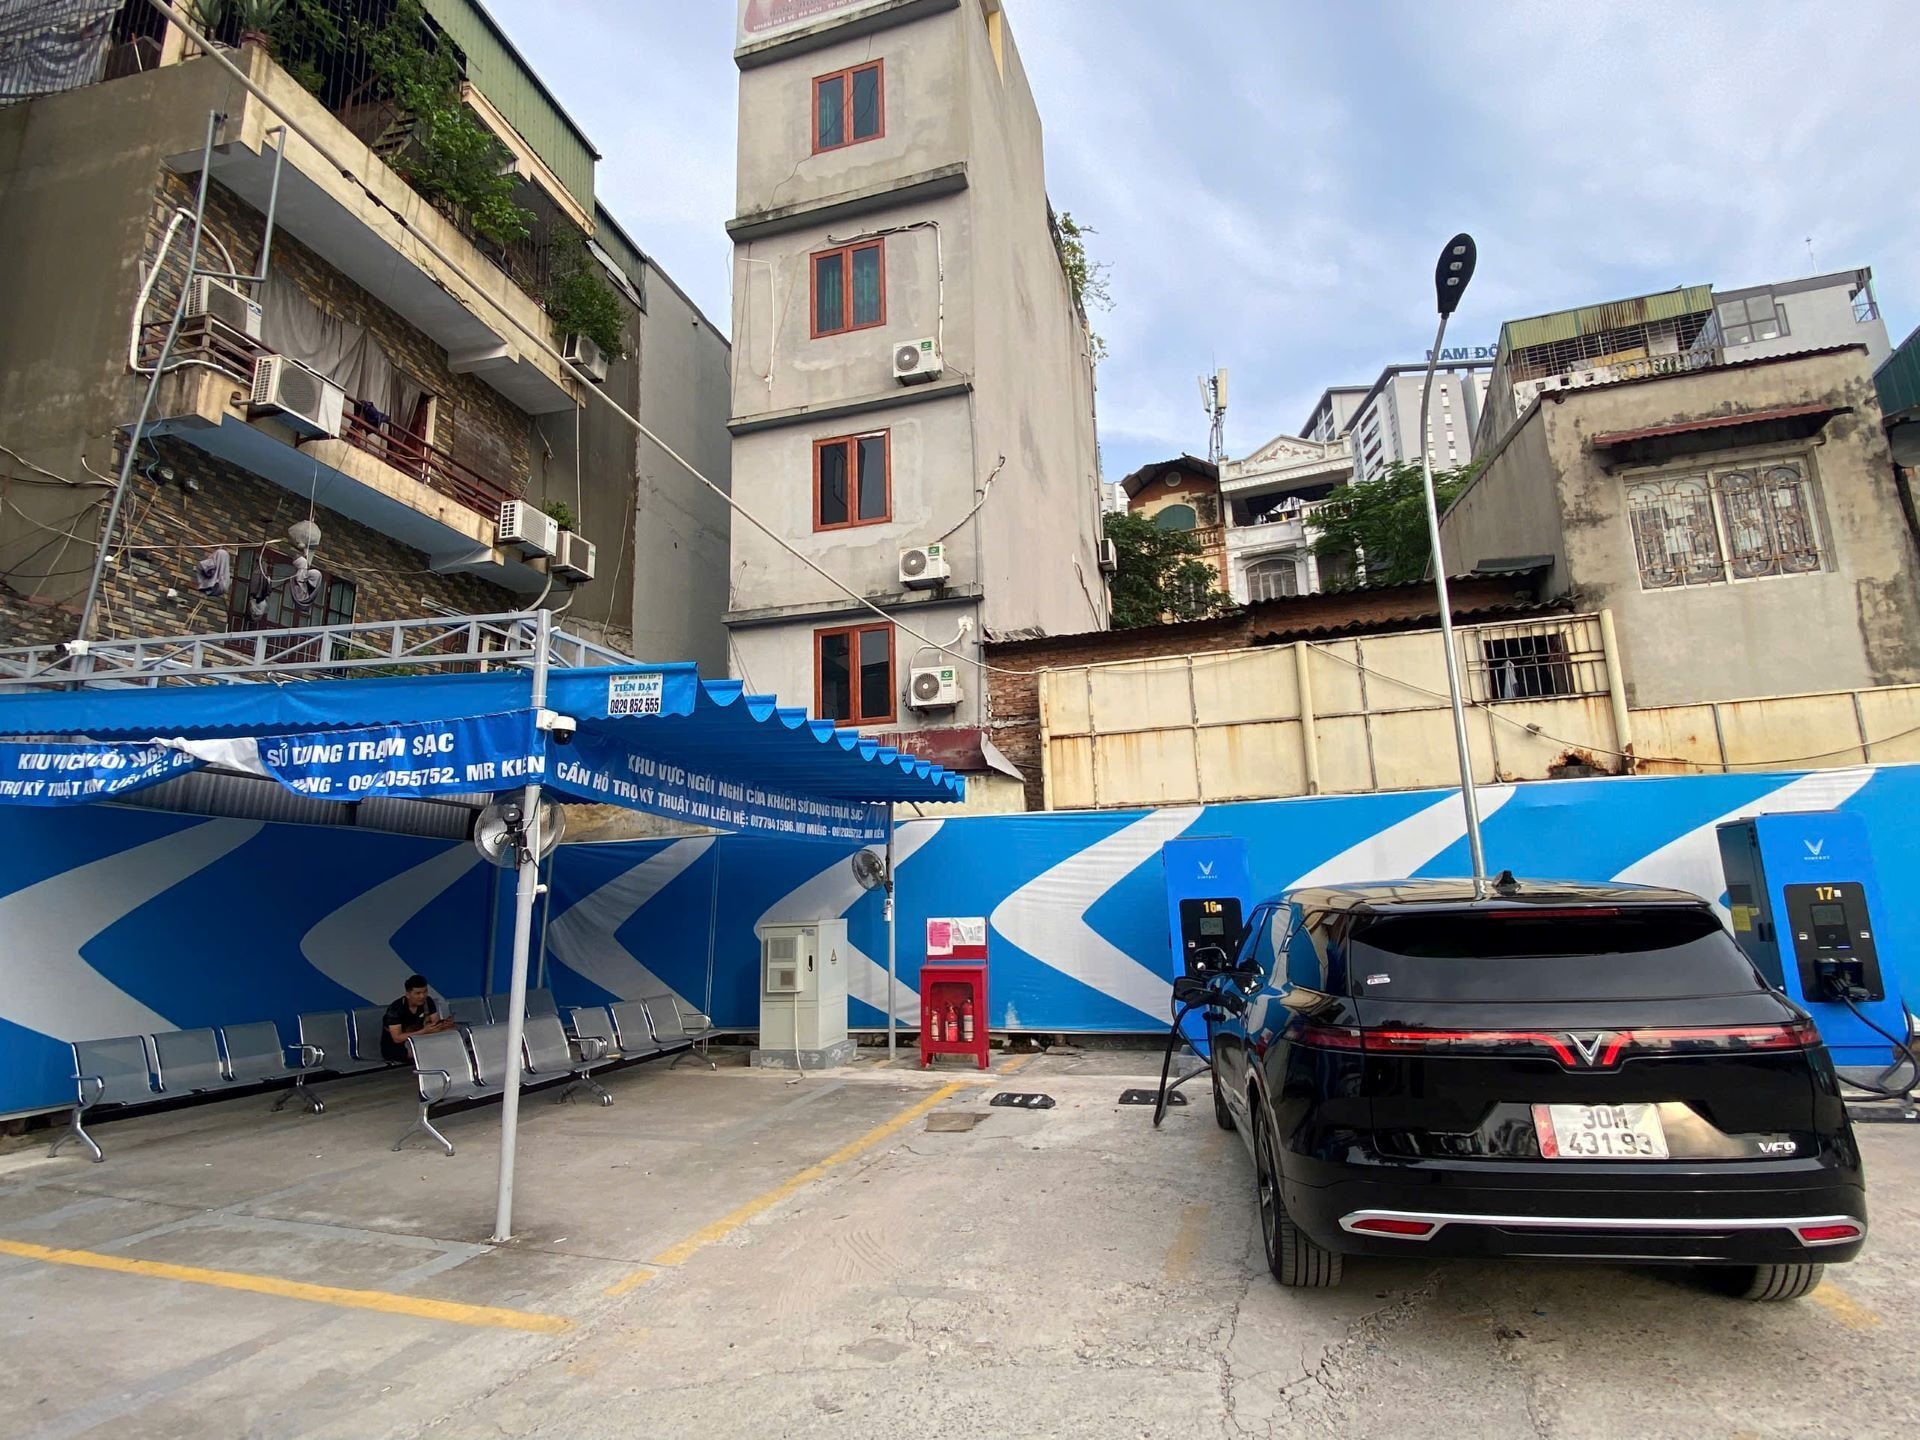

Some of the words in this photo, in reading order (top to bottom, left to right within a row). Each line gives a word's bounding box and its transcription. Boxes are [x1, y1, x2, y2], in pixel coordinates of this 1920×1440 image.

[1426, 347, 1469, 361] NAM
[614, 680, 636, 692] TIẾN
[610, 699, 628, 714] 0929
[629, 698, 644, 713] 852
[644, 697, 660, 713] 555
[348, 738, 406, 763] TRẠM
[412, 733, 454, 758] SẠC
[466, 762, 495, 781] MR
[627, 753, 656, 777] KHU
[659, 764, 685, 787] VỰC
[22, 779, 46, 796] KỸ
[557, 761, 591, 786] CẦN
[658, 792, 690, 815] THUẬT
[691, 801, 710, 818] XIN
[710, 806, 732, 822] LIÊN
[733, 810, 748, 828] HỆ:
[1816, 887, 1834, 900] 17
[1203, 901, 1217, 913] 16
[1580, 1106, 1629, 1129] 30M
[1569, 1132, 1653, 1155] 431.93
[1758, 1141, 1796, 1154] VF9
